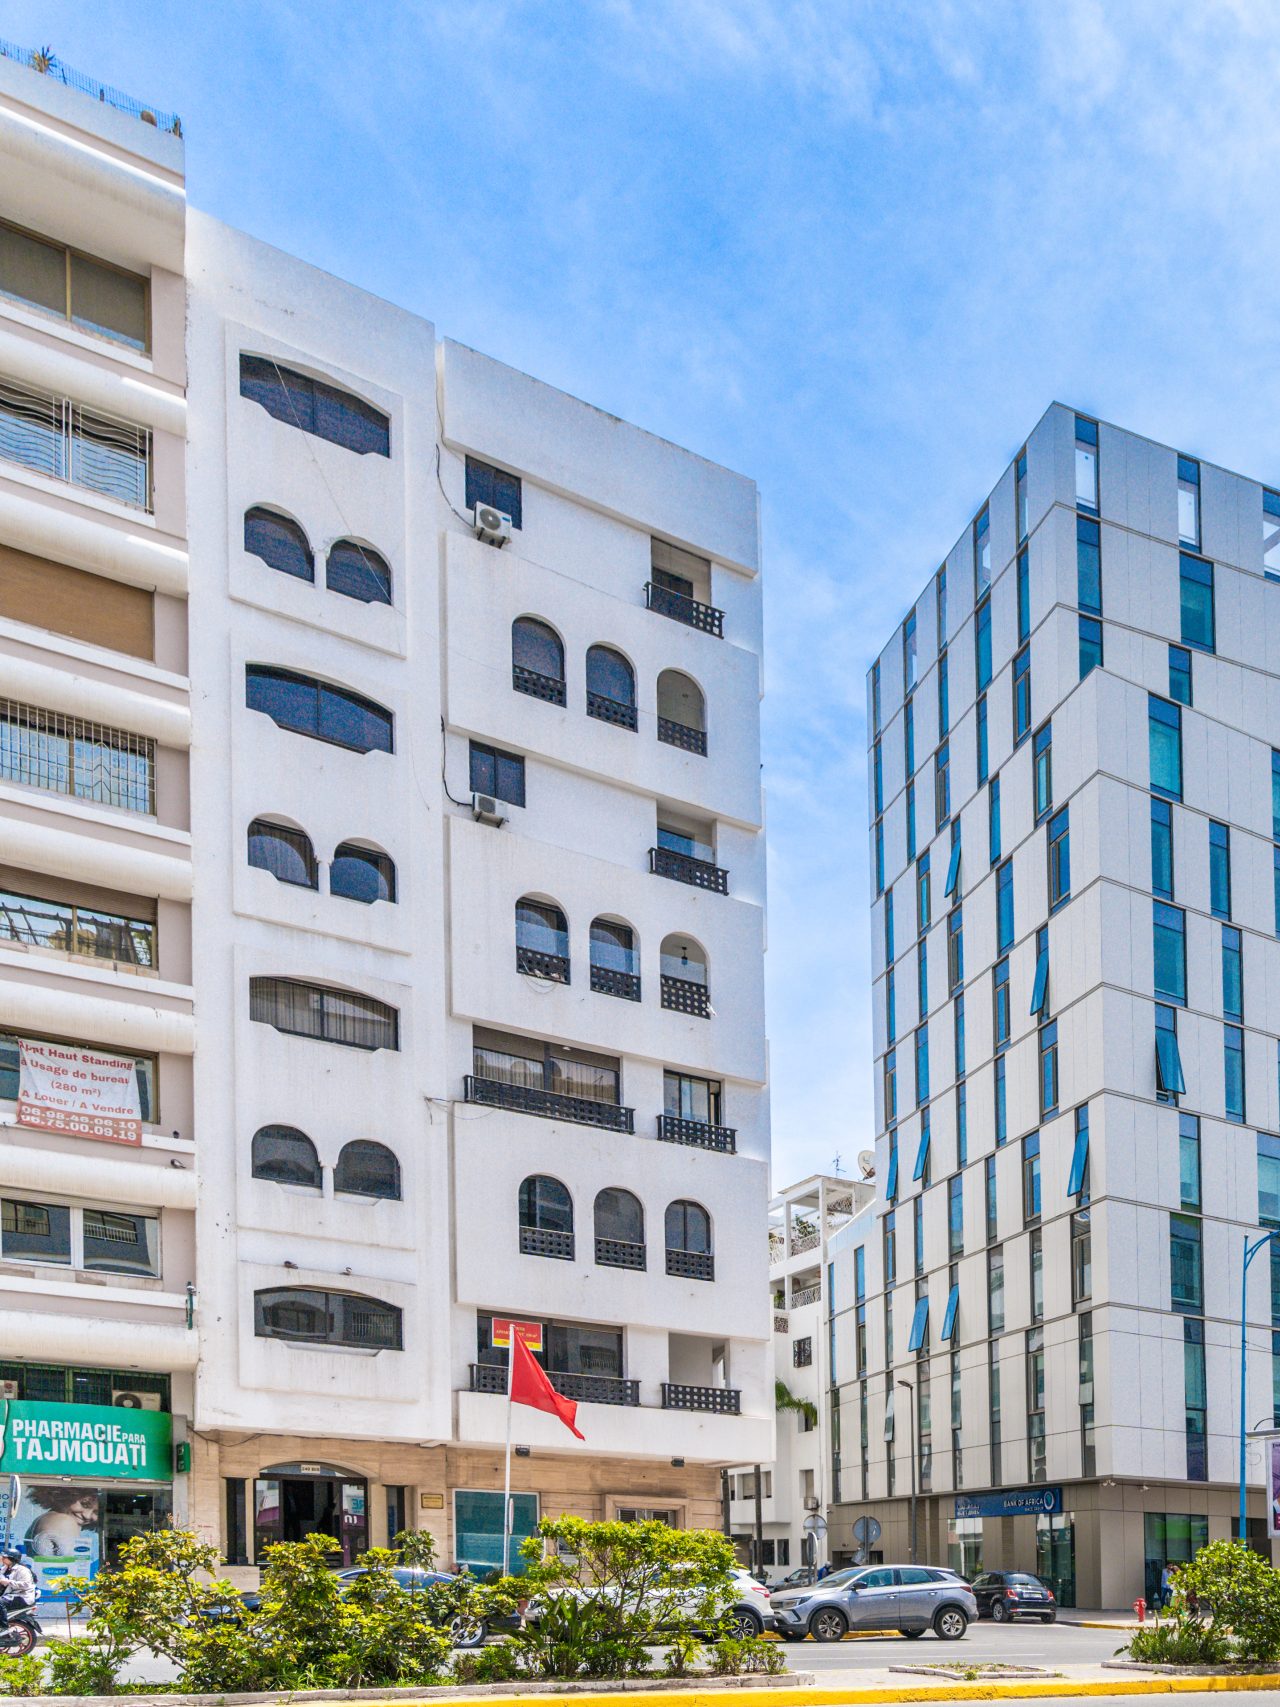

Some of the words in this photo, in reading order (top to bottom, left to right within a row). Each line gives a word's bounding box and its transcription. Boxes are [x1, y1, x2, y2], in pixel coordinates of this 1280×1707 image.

[30, 1059, 68, 1076] Usage
[72, 1069, 87, 1080] de
[48, 1048, 77, 1061] Haut
[81, 1055, 133, 1071] Standing
[51, 1080, 77, 1093] (280
[21, 1089, 30, 1098] A
[34, 1092, 69, 1106] Louer
[80, 1102, 88, 1110] A
[92, 1103, 134, 1115] Vendre
[12, 1419, 122, 1442] PHARMACIE
[121, 1432, 146, 1444] PARA
[13, 1437, 147, 1466] TAJMOUATI
[1003, 1500, 1017, 1508] BANK
[1018, 1499, 1024, 1507] OF
[1025, 1497, 1044, 1506] AFRICA
